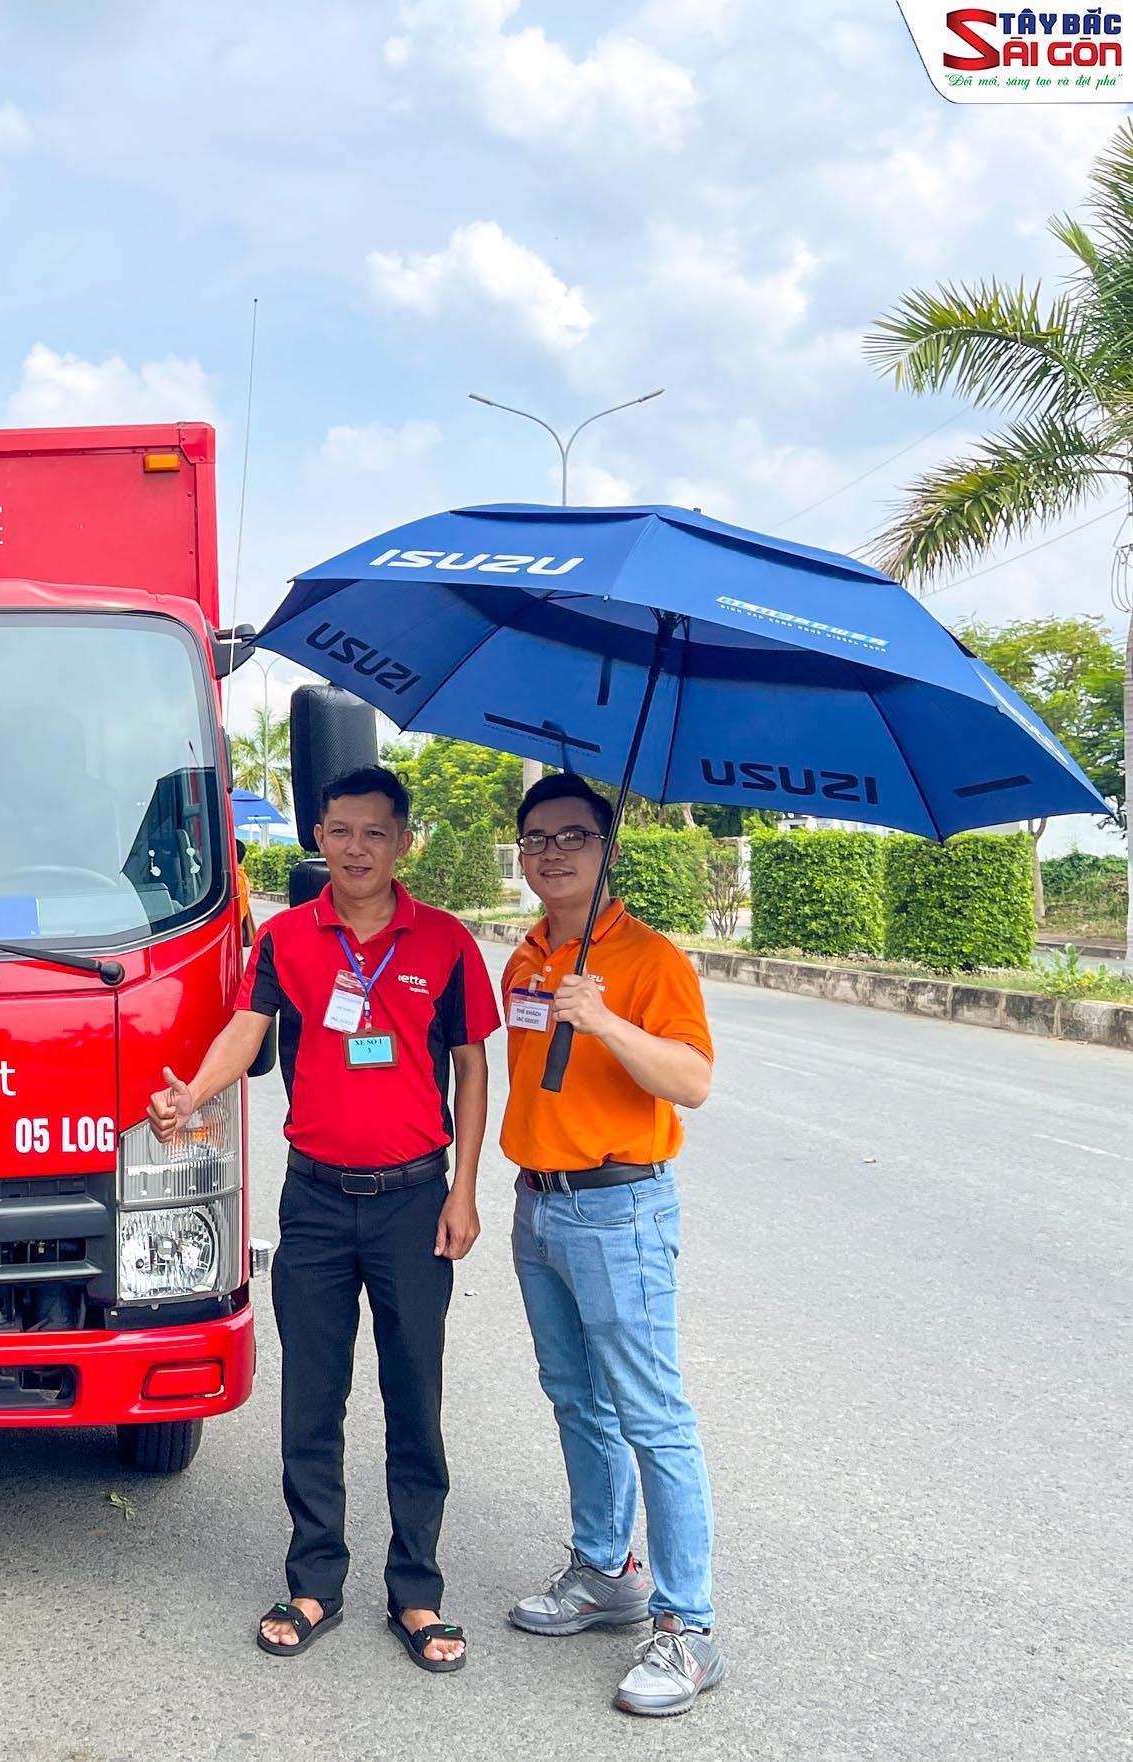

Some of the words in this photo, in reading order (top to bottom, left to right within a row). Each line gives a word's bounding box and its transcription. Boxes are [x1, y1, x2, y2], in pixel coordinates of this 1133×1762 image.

[369, 549, 584, 575] ISUZU
[15, 1118, 50, 1153] 05
[62, 1116, 115, 1153] LOG
